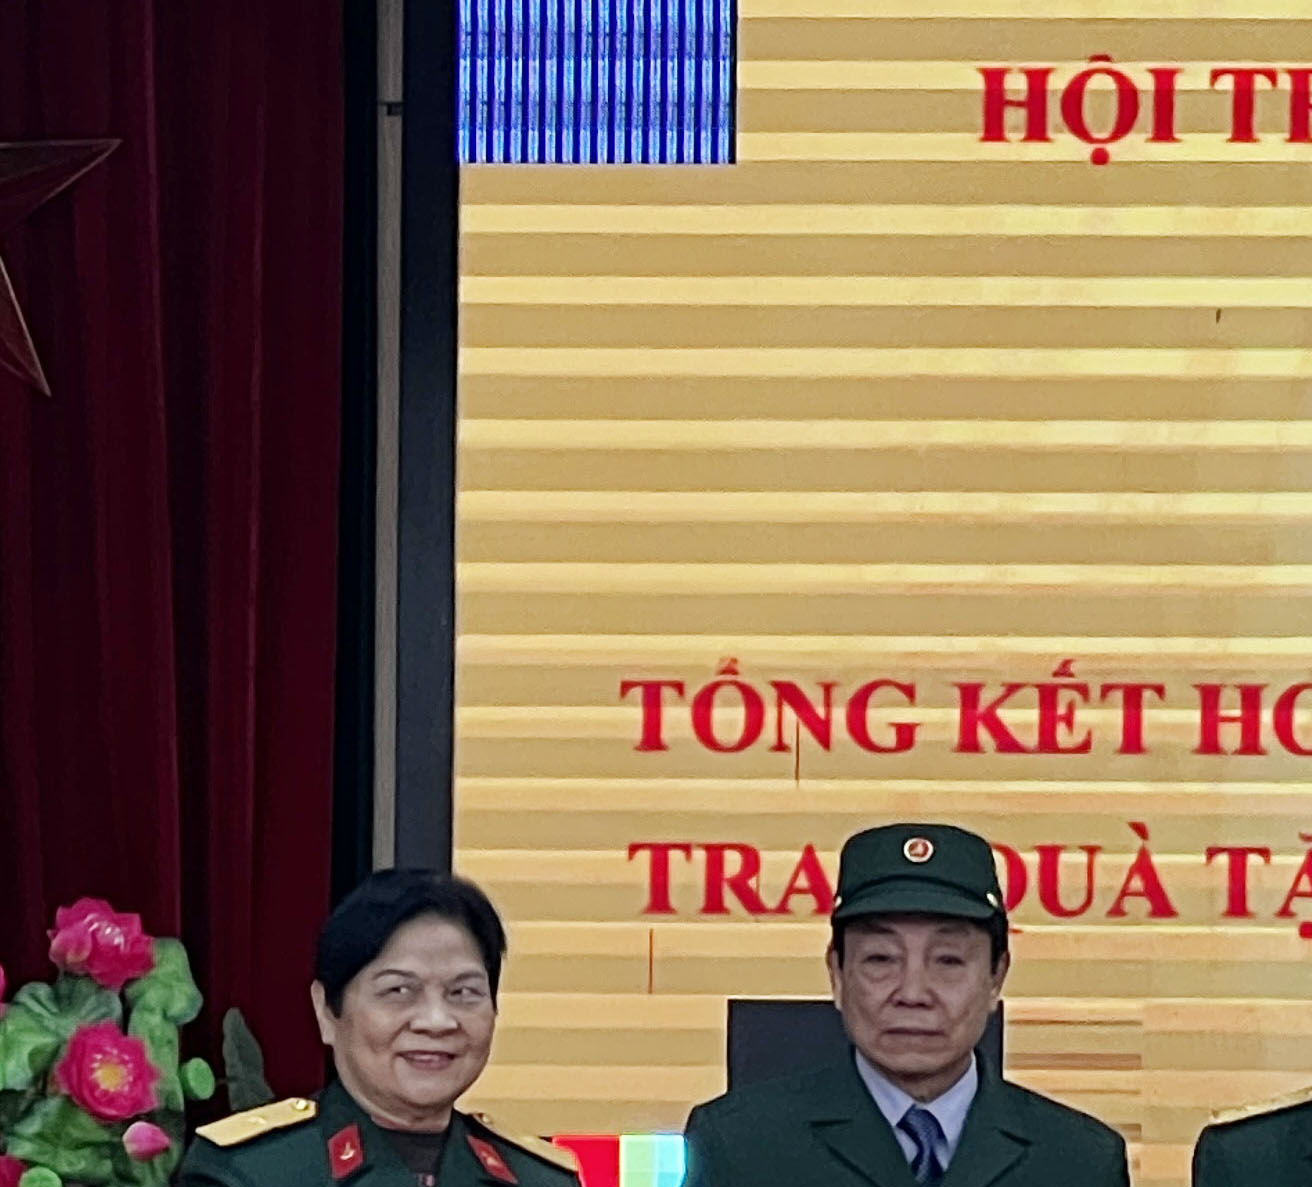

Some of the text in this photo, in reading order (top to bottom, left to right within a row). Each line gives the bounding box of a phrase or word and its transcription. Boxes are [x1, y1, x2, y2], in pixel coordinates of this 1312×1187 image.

[978, 53, 1181, 166] HỘI
[619, 658, 922, 754] TỔNG
[953, 658, 1165, 756] KẾT
